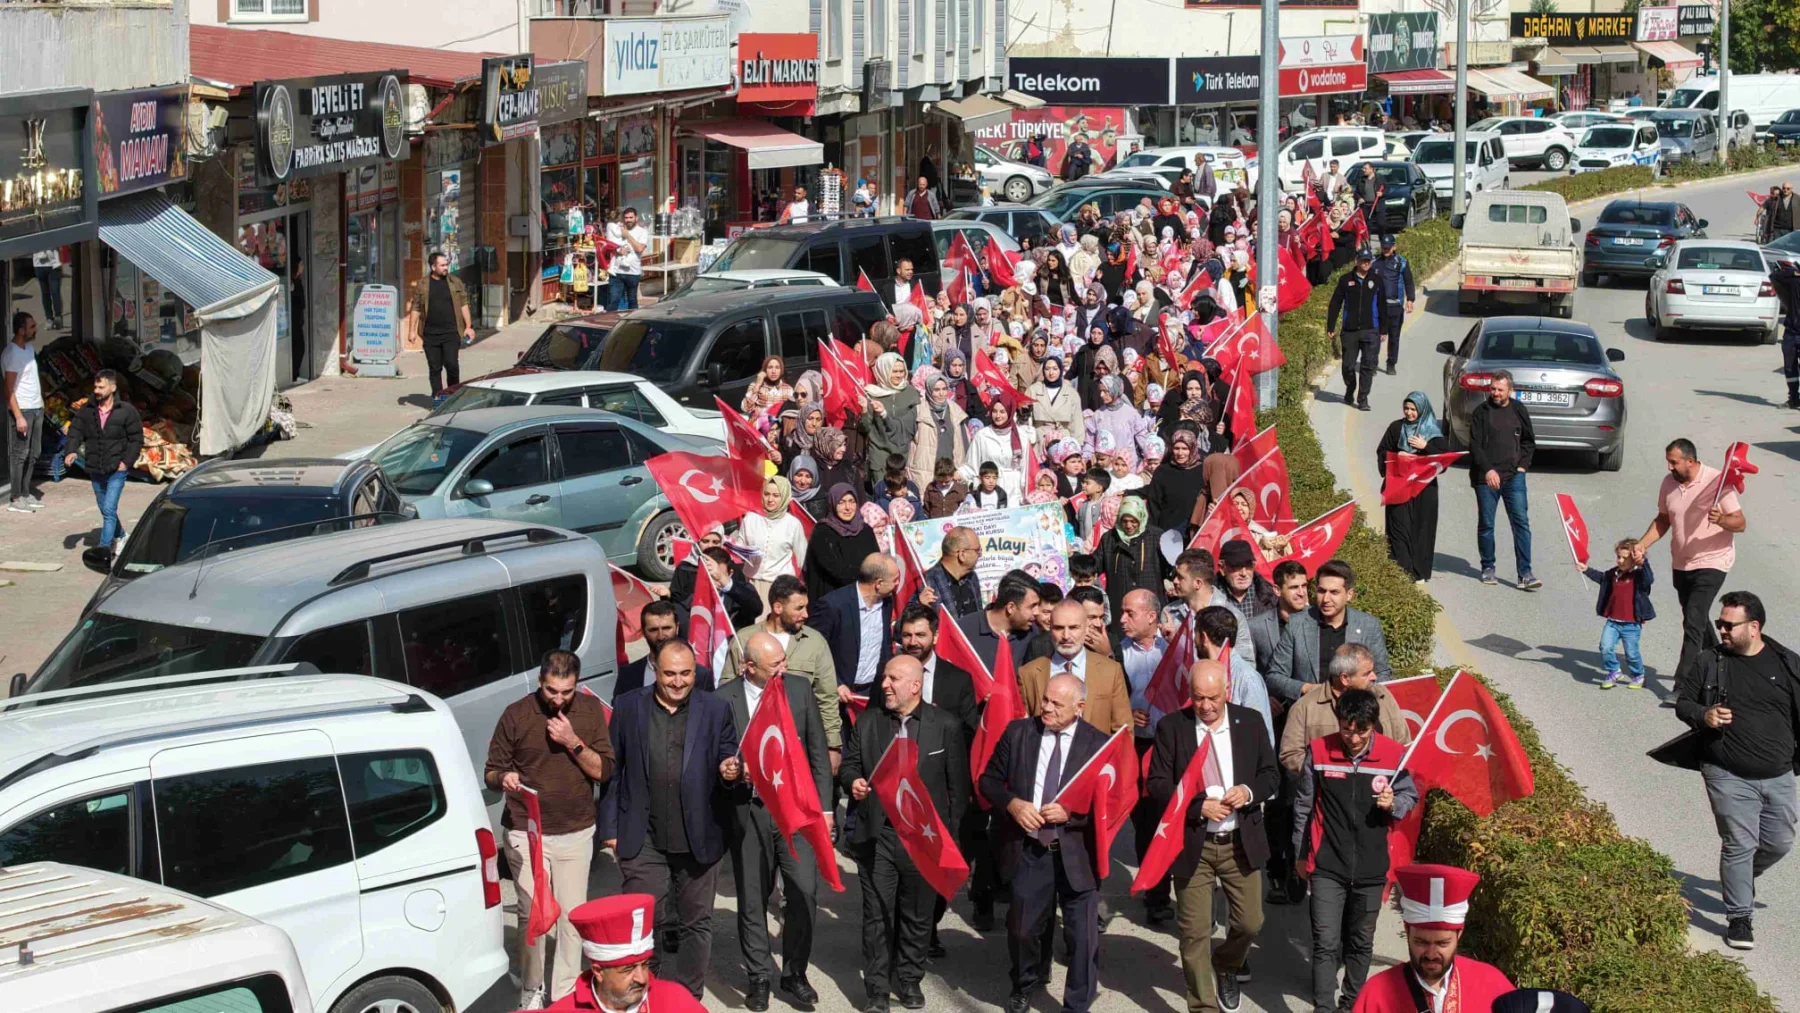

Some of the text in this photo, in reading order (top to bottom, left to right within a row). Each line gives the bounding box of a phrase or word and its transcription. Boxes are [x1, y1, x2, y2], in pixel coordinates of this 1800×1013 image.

[1524, 13, 1571, 37] DAĞHAN
[1588, 17, 1633, 36] MARKET
[662, 32, 673, 51] ET
[674, 32, 682, 51] &
[615, 32, 658, 80] yıldız
[744, 51, 771, 84] ELİT
[772, 59, 821, 84] MARKET
[1310, 69, 1347, 87] vodafone
[1014, 73, 1100, 92] Telekom
[1204, 72, 1259, 90] Türk Telekom
[351, 83, 365, 110] ET
[540, 81, 568, 112] YUSUF
[130, 101, 157, 133] AYDIN
[1010, 119, 1065, 139] TÜRKİYE!
[325, 142, 345, 164] SATIŞ
[346, 135, 380, 160] MAĞAZASI
[1522, 393, 1532, 401] 38
[1547, 394, 1568, 402] 3962
[986, 537, 1026, 556] Alayı
